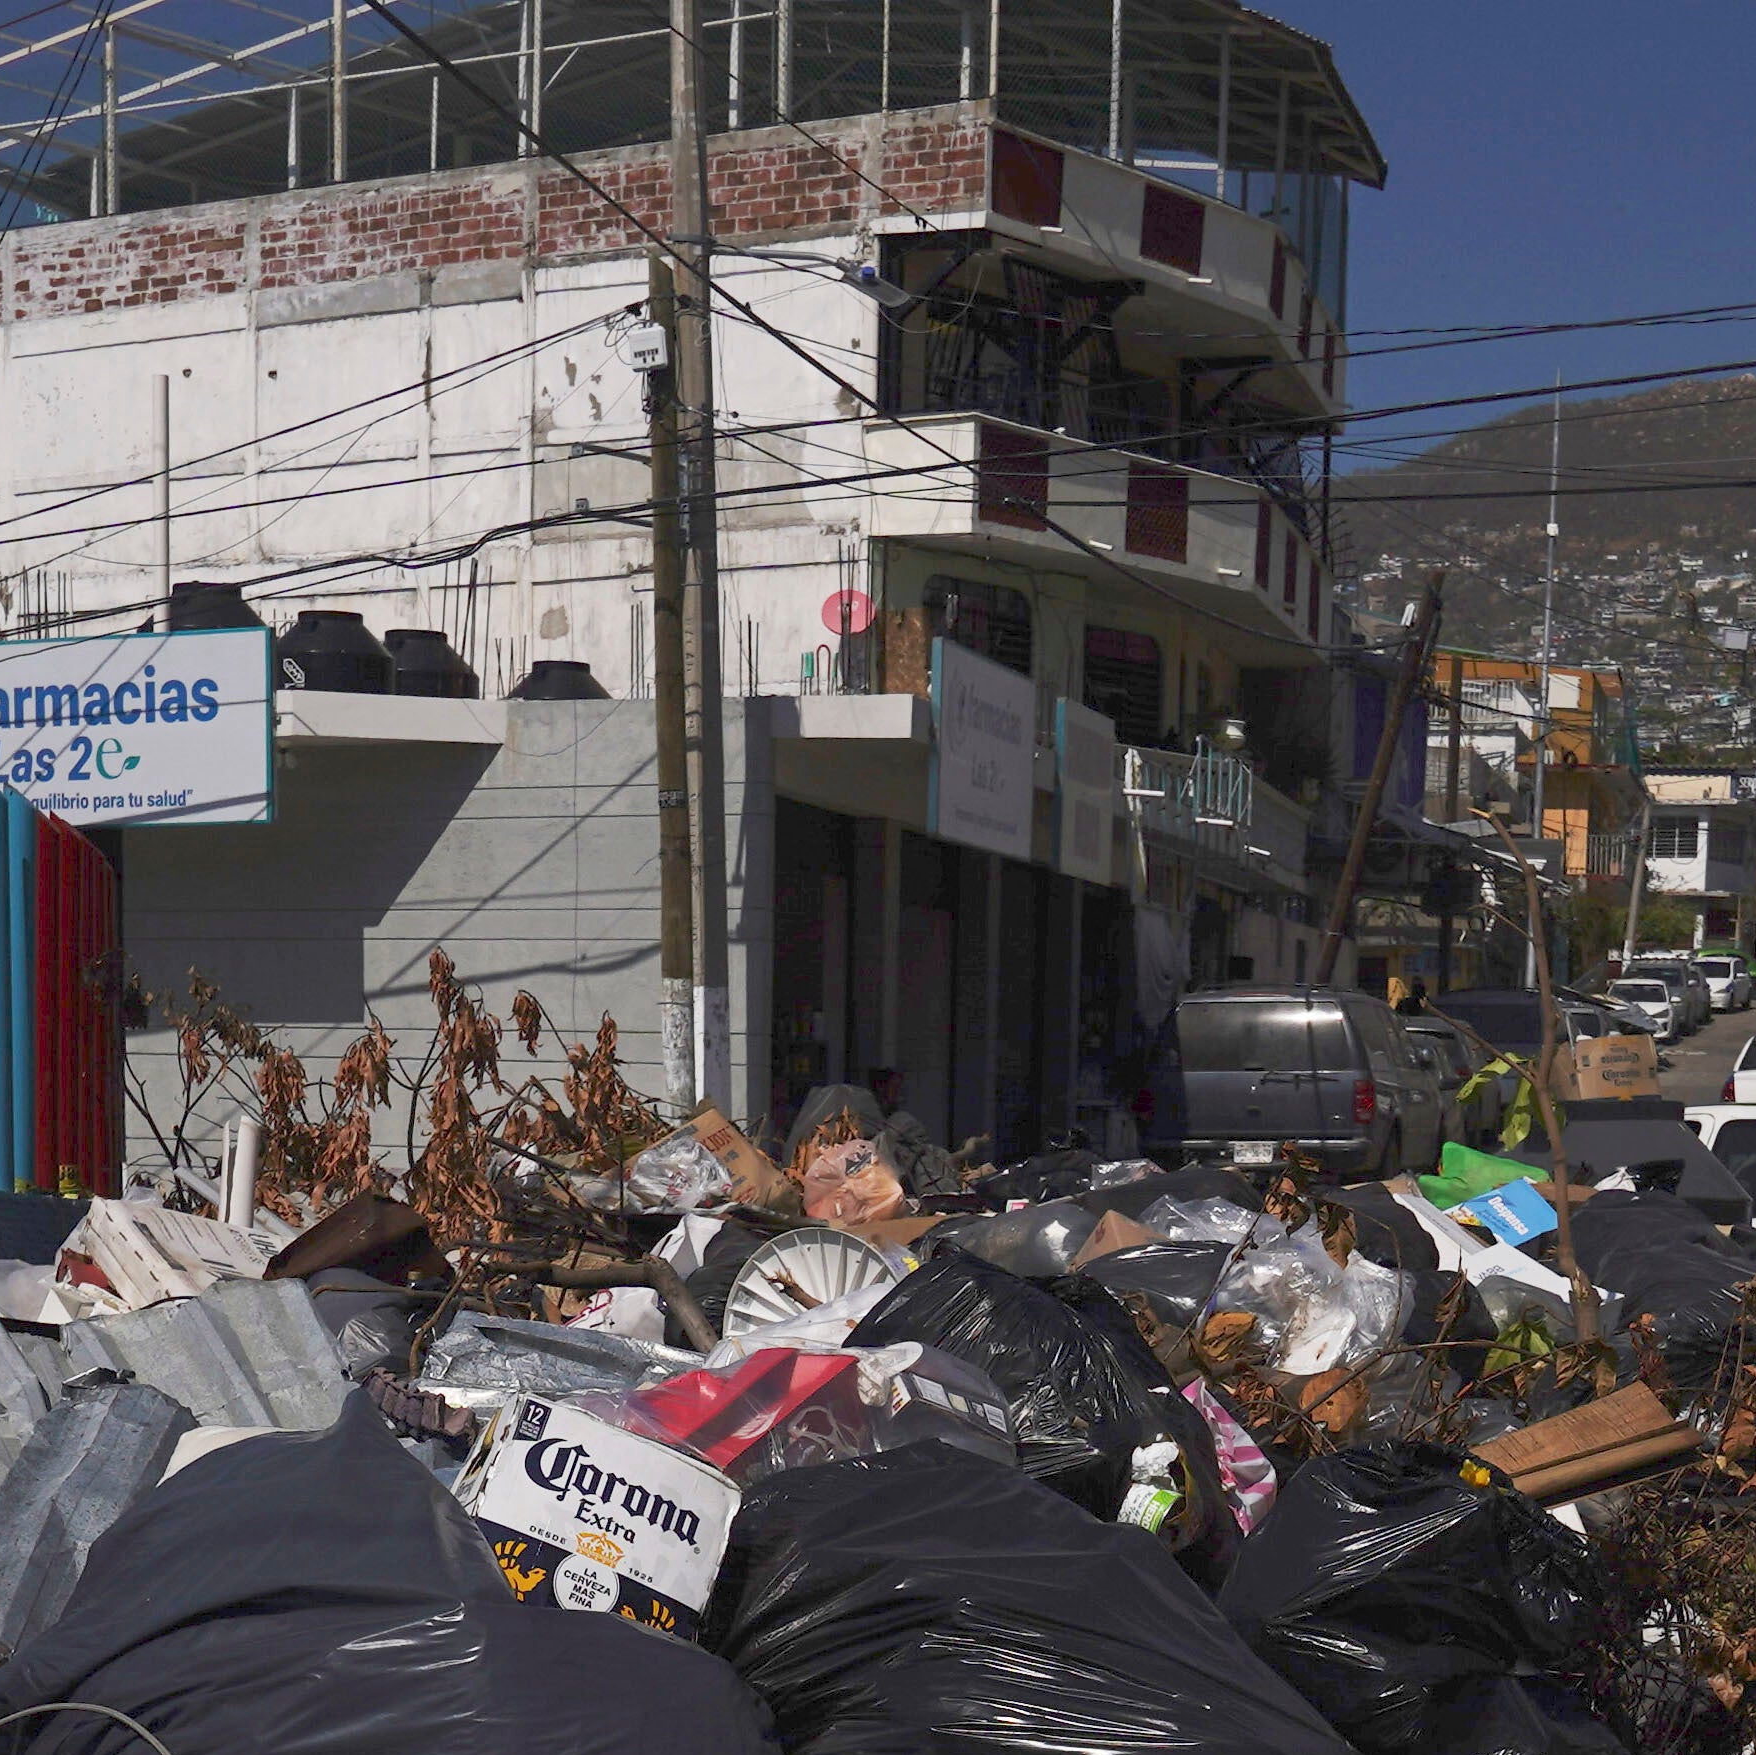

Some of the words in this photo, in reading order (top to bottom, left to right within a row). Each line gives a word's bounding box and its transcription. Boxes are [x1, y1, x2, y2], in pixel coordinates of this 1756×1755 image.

[31, 792, 89, 810] quilibrio
[93, 795, 125, 811] para
[129, 793, 143, 808] tu
[527, 1404, 544, 1425] 12
[524, 1438, 701, 1547] Corona
[574, 1499, 636, 1544] Extra
[529, 1525, 567, 1545] DESDE
[563, 1569, 611, 1596] CERVEZA
[583, 1567, 597, 1579] LA
[568, 1592, 592, 1609] FINA
[572, 1583, 596, 1600] MAS
